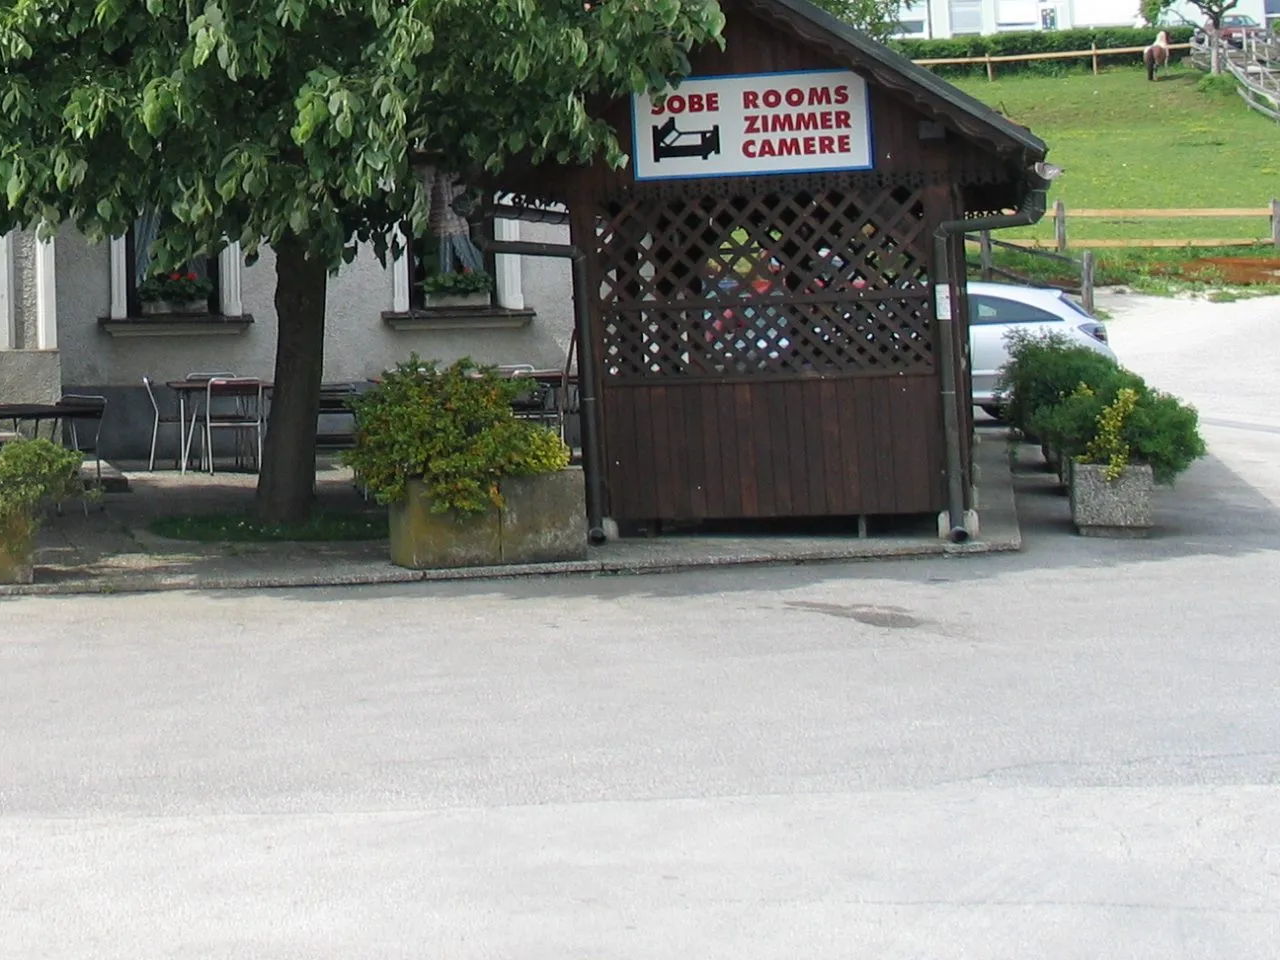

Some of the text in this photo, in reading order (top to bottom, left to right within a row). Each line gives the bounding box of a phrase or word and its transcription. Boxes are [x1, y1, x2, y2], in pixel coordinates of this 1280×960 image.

[742, 85, 850, 109] ROOMS
[743, 110, 852, 134] ZIMMER
[741, 135, 852, 159] CAMERE
